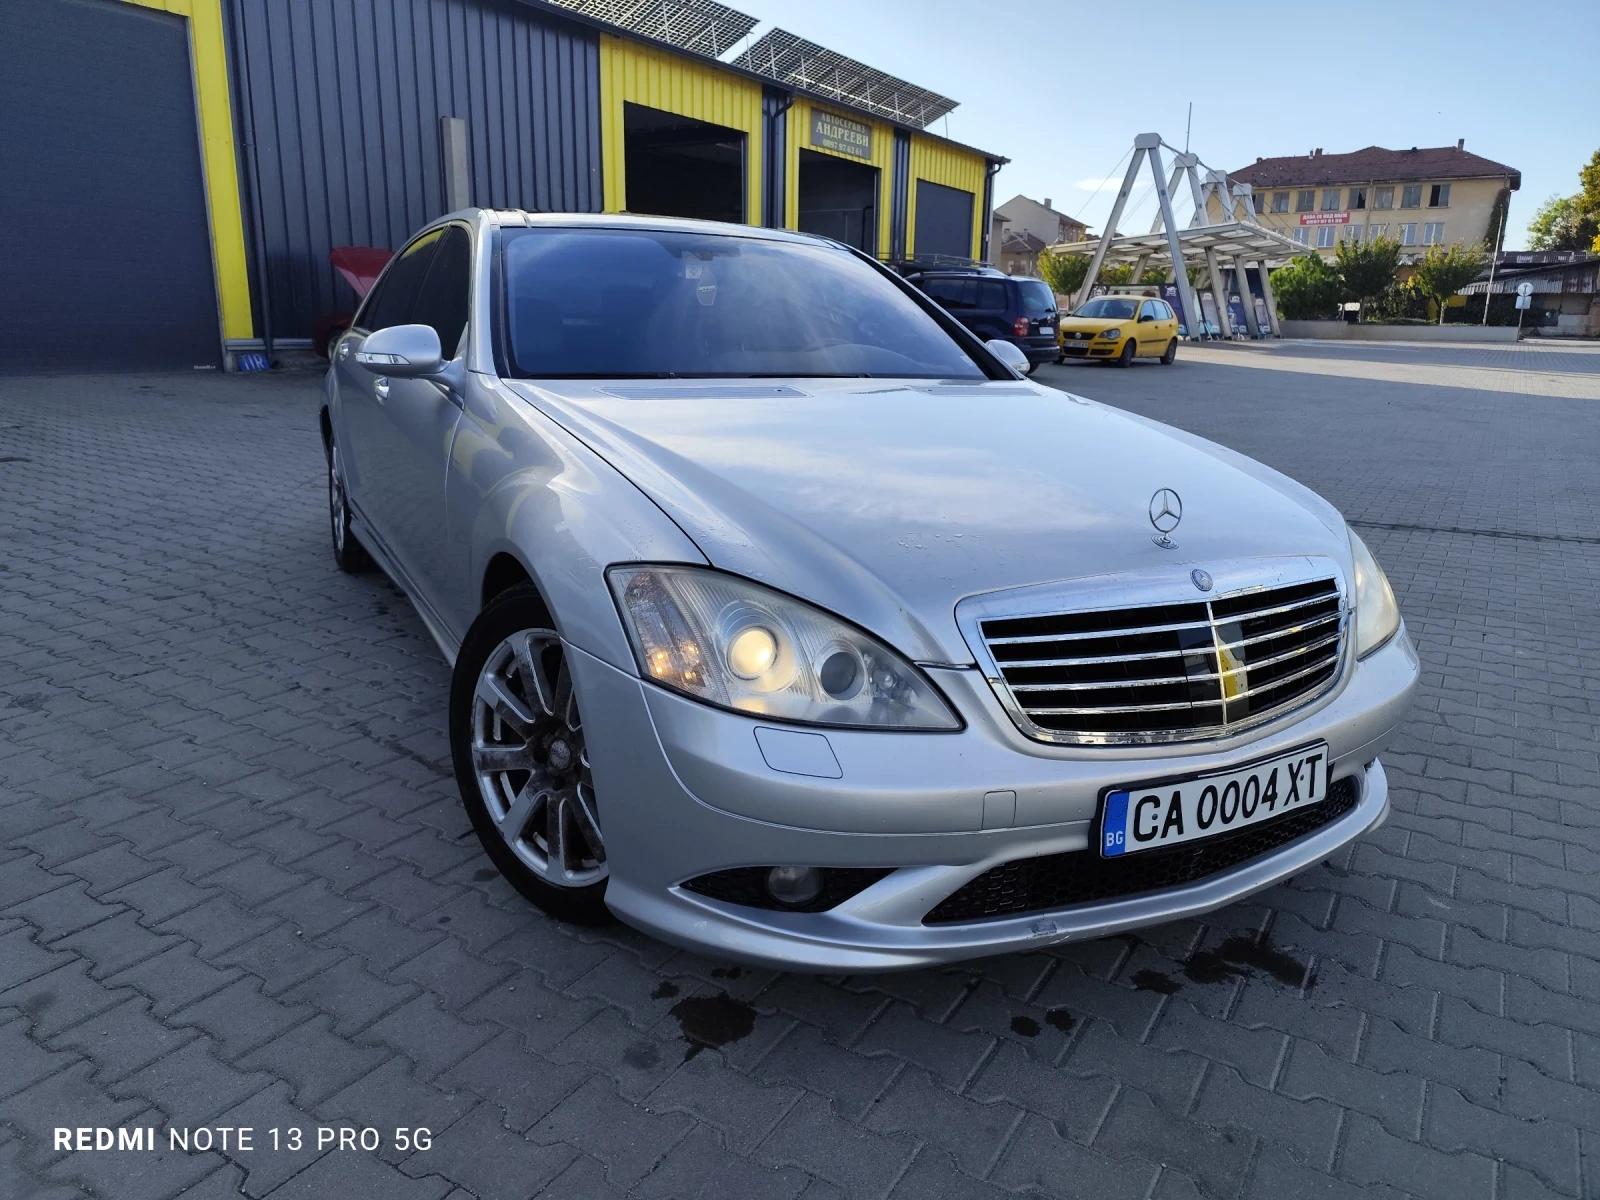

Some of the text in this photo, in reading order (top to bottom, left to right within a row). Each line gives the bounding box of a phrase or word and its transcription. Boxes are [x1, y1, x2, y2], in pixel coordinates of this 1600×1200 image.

[816, 121, 869, 147] АНДРЕЕВИ
[1133, 753, 1323, 842] CA 0004 XT
[1106, 831, 1123, 847] BG
